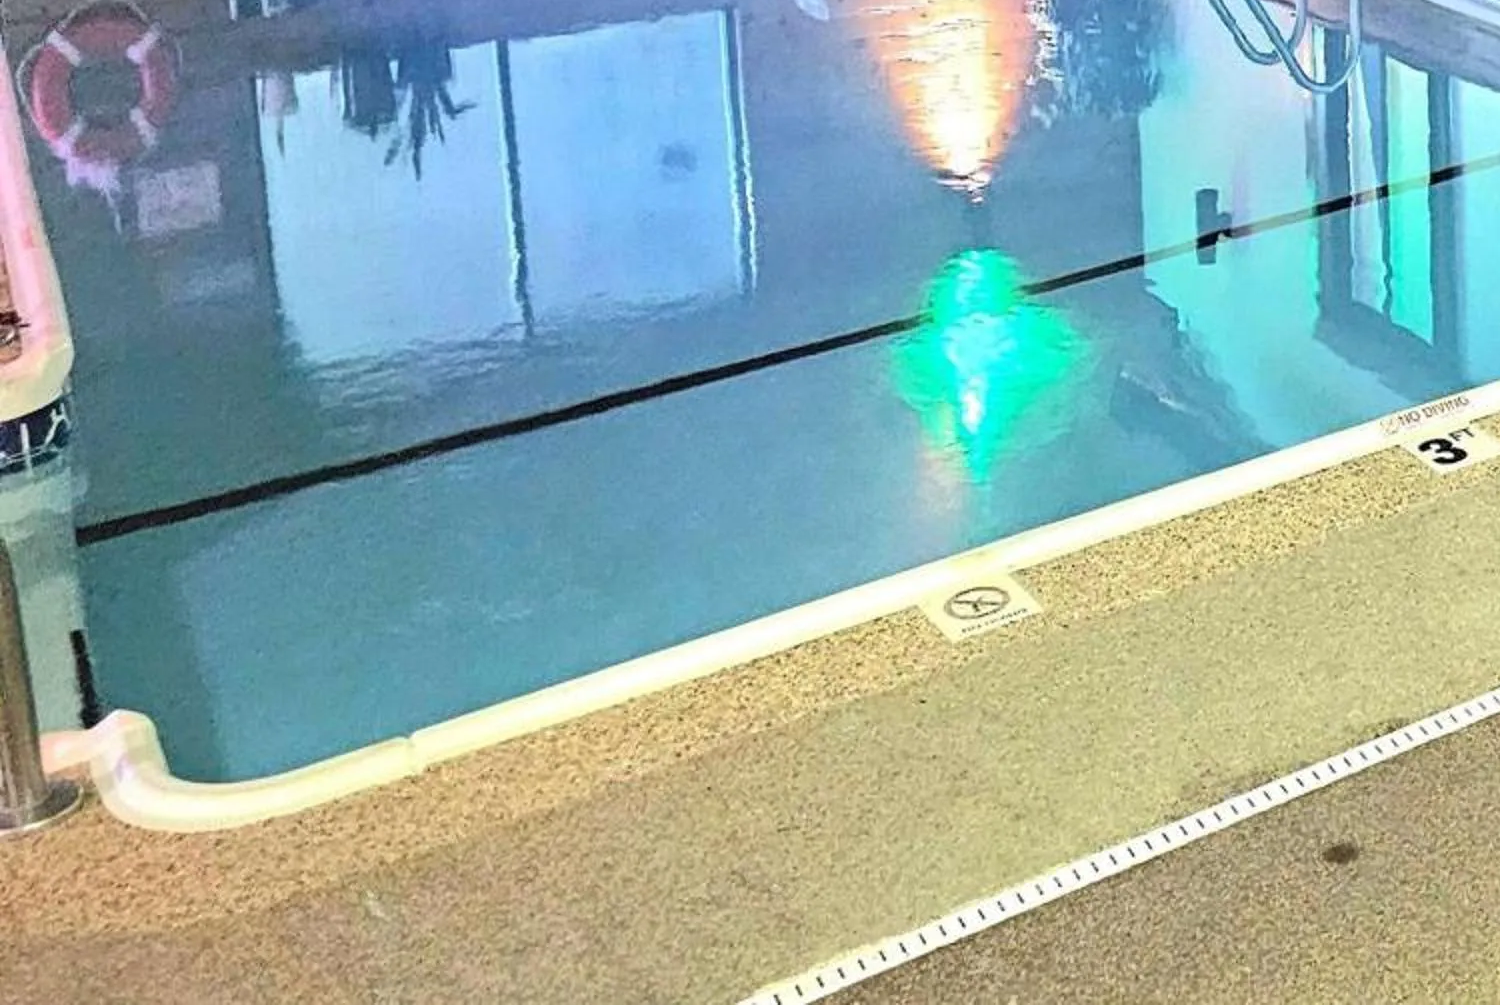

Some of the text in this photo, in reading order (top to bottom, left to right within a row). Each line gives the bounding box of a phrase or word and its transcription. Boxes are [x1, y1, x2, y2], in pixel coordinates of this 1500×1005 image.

[1397, 395, 1470, 426] NO DIVING
[1417, 426, 1475, 465] 3 FT
